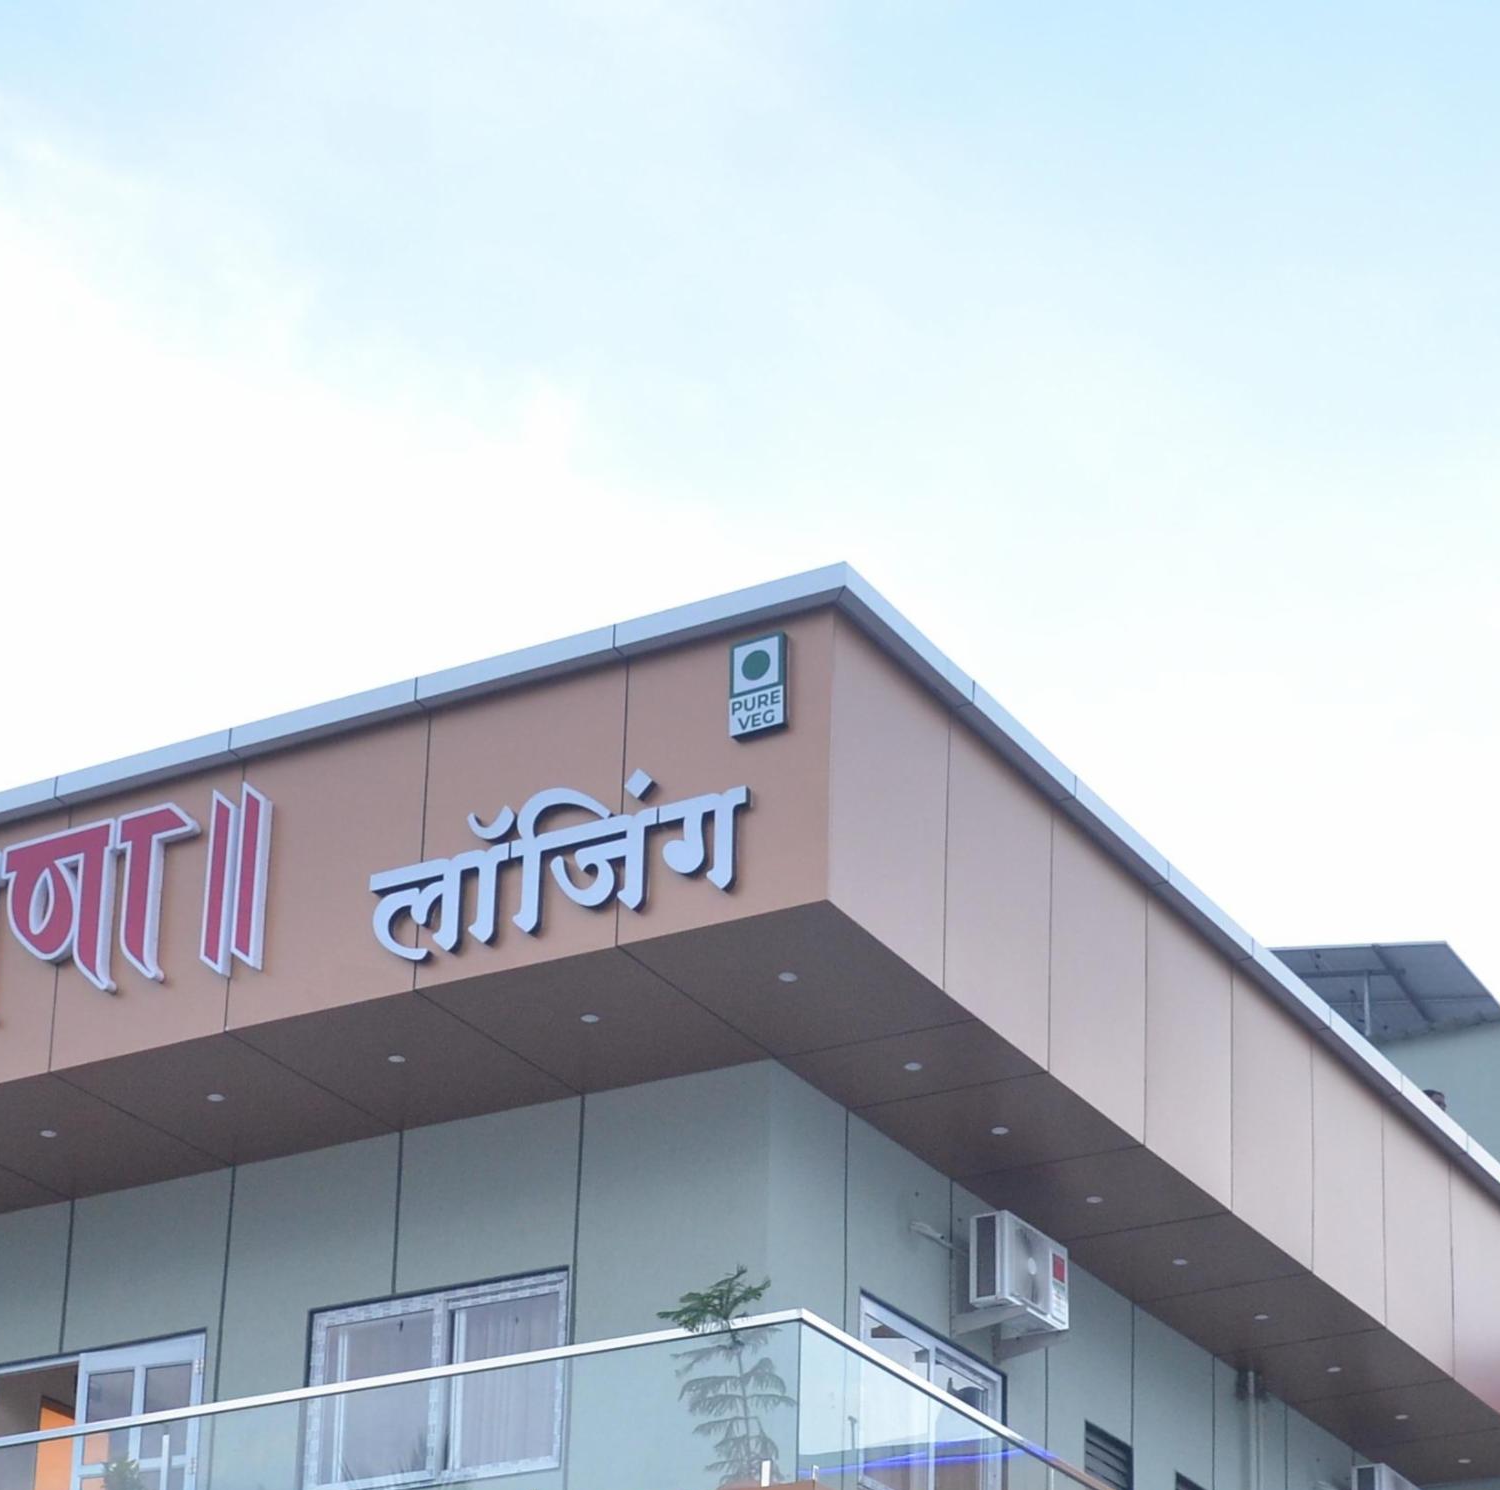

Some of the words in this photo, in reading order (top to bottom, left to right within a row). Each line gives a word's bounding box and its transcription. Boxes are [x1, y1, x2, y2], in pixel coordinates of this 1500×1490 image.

[730, 689, 781, 716] PURE
[737, 708, 775, 731] VEG
[369, 768, 750, 962] लॉजिंग
